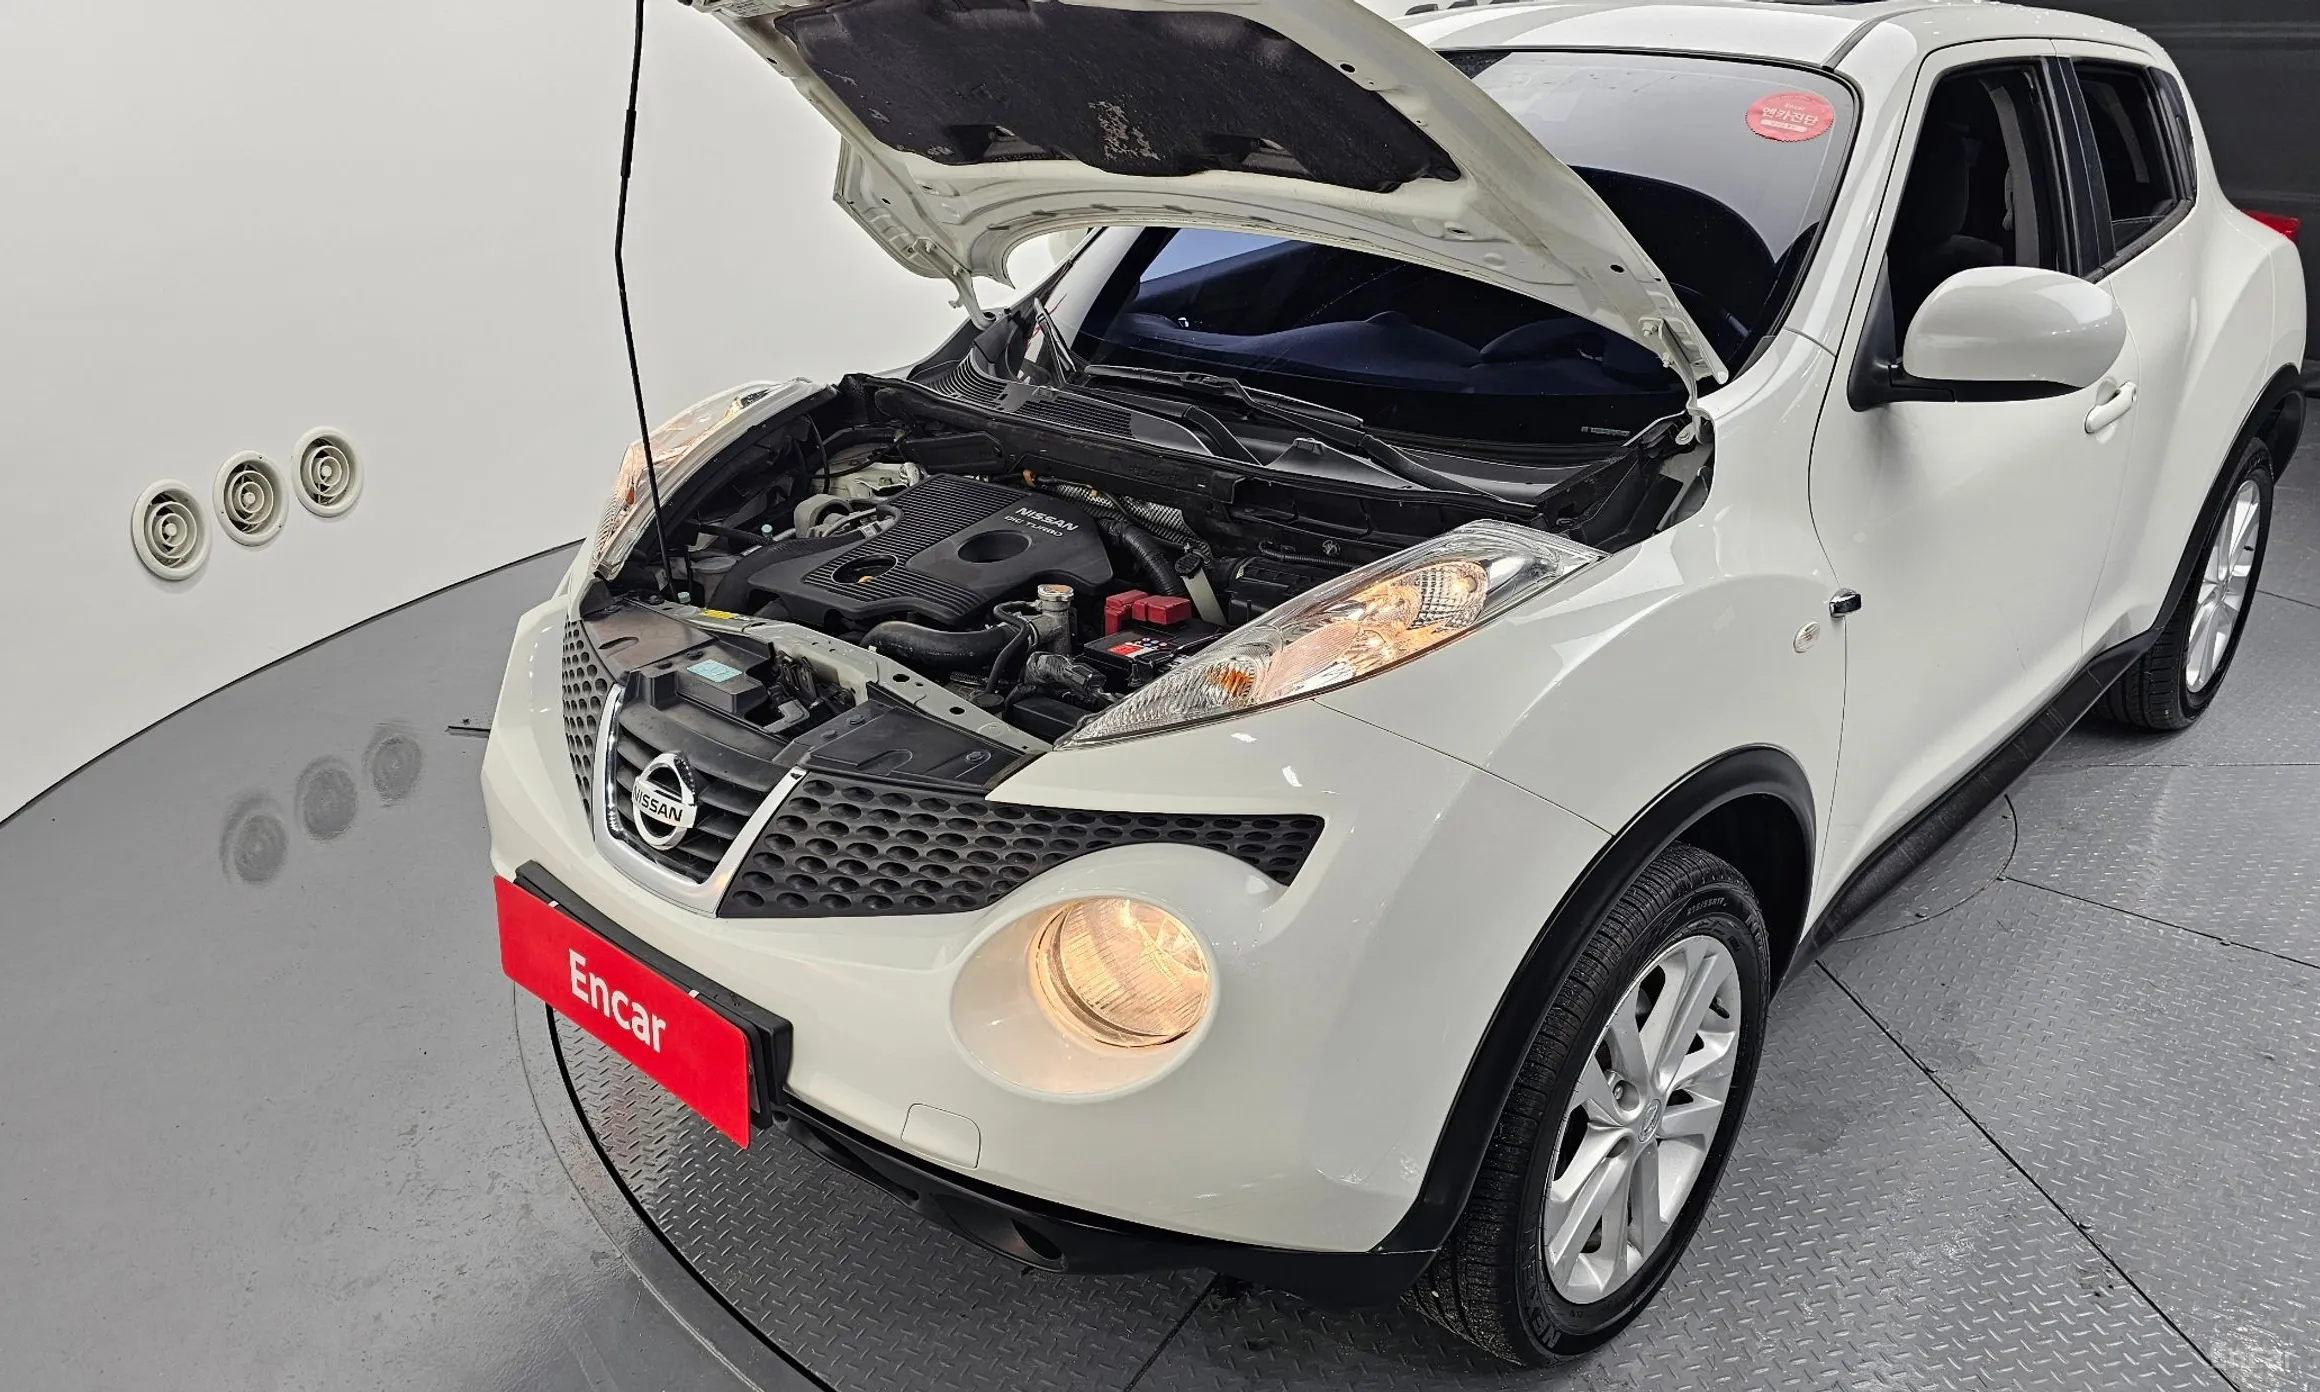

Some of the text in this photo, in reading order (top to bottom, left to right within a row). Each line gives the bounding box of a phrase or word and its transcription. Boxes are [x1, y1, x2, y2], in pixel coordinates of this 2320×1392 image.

[1762, 106, 1820, 126] 엔카진단
[1015, 507, 1079, 531] NISSAN
[1025, 521, 1064, 537] TURBO
[632, 785, 683, 822] NISSAN
[568, 947, 667, 1054] Encar
